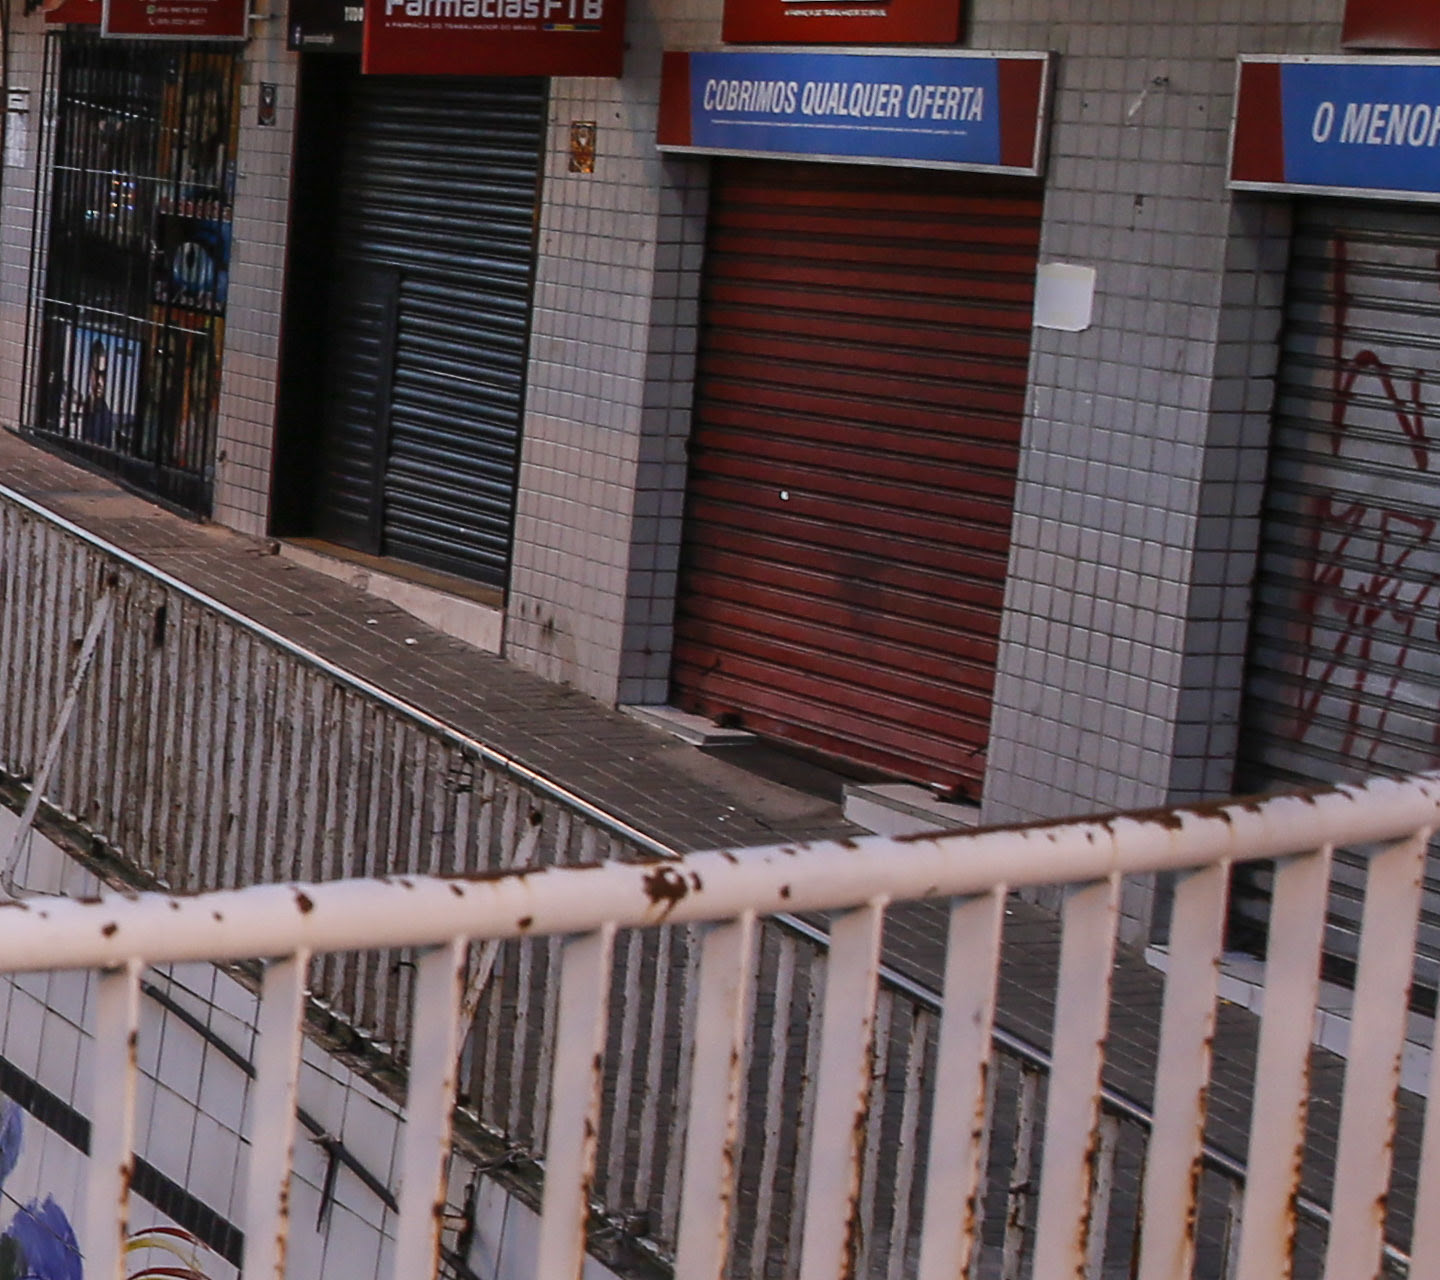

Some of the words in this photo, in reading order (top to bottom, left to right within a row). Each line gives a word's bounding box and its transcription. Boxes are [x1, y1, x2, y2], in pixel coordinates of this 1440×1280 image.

[704, 79, 798, 115] COBRIMOS
[800, 82, 904, 118] QUALQUER
[906, 84, 985, 122] OFERTA
[1312, 101, 1335, 143] O
